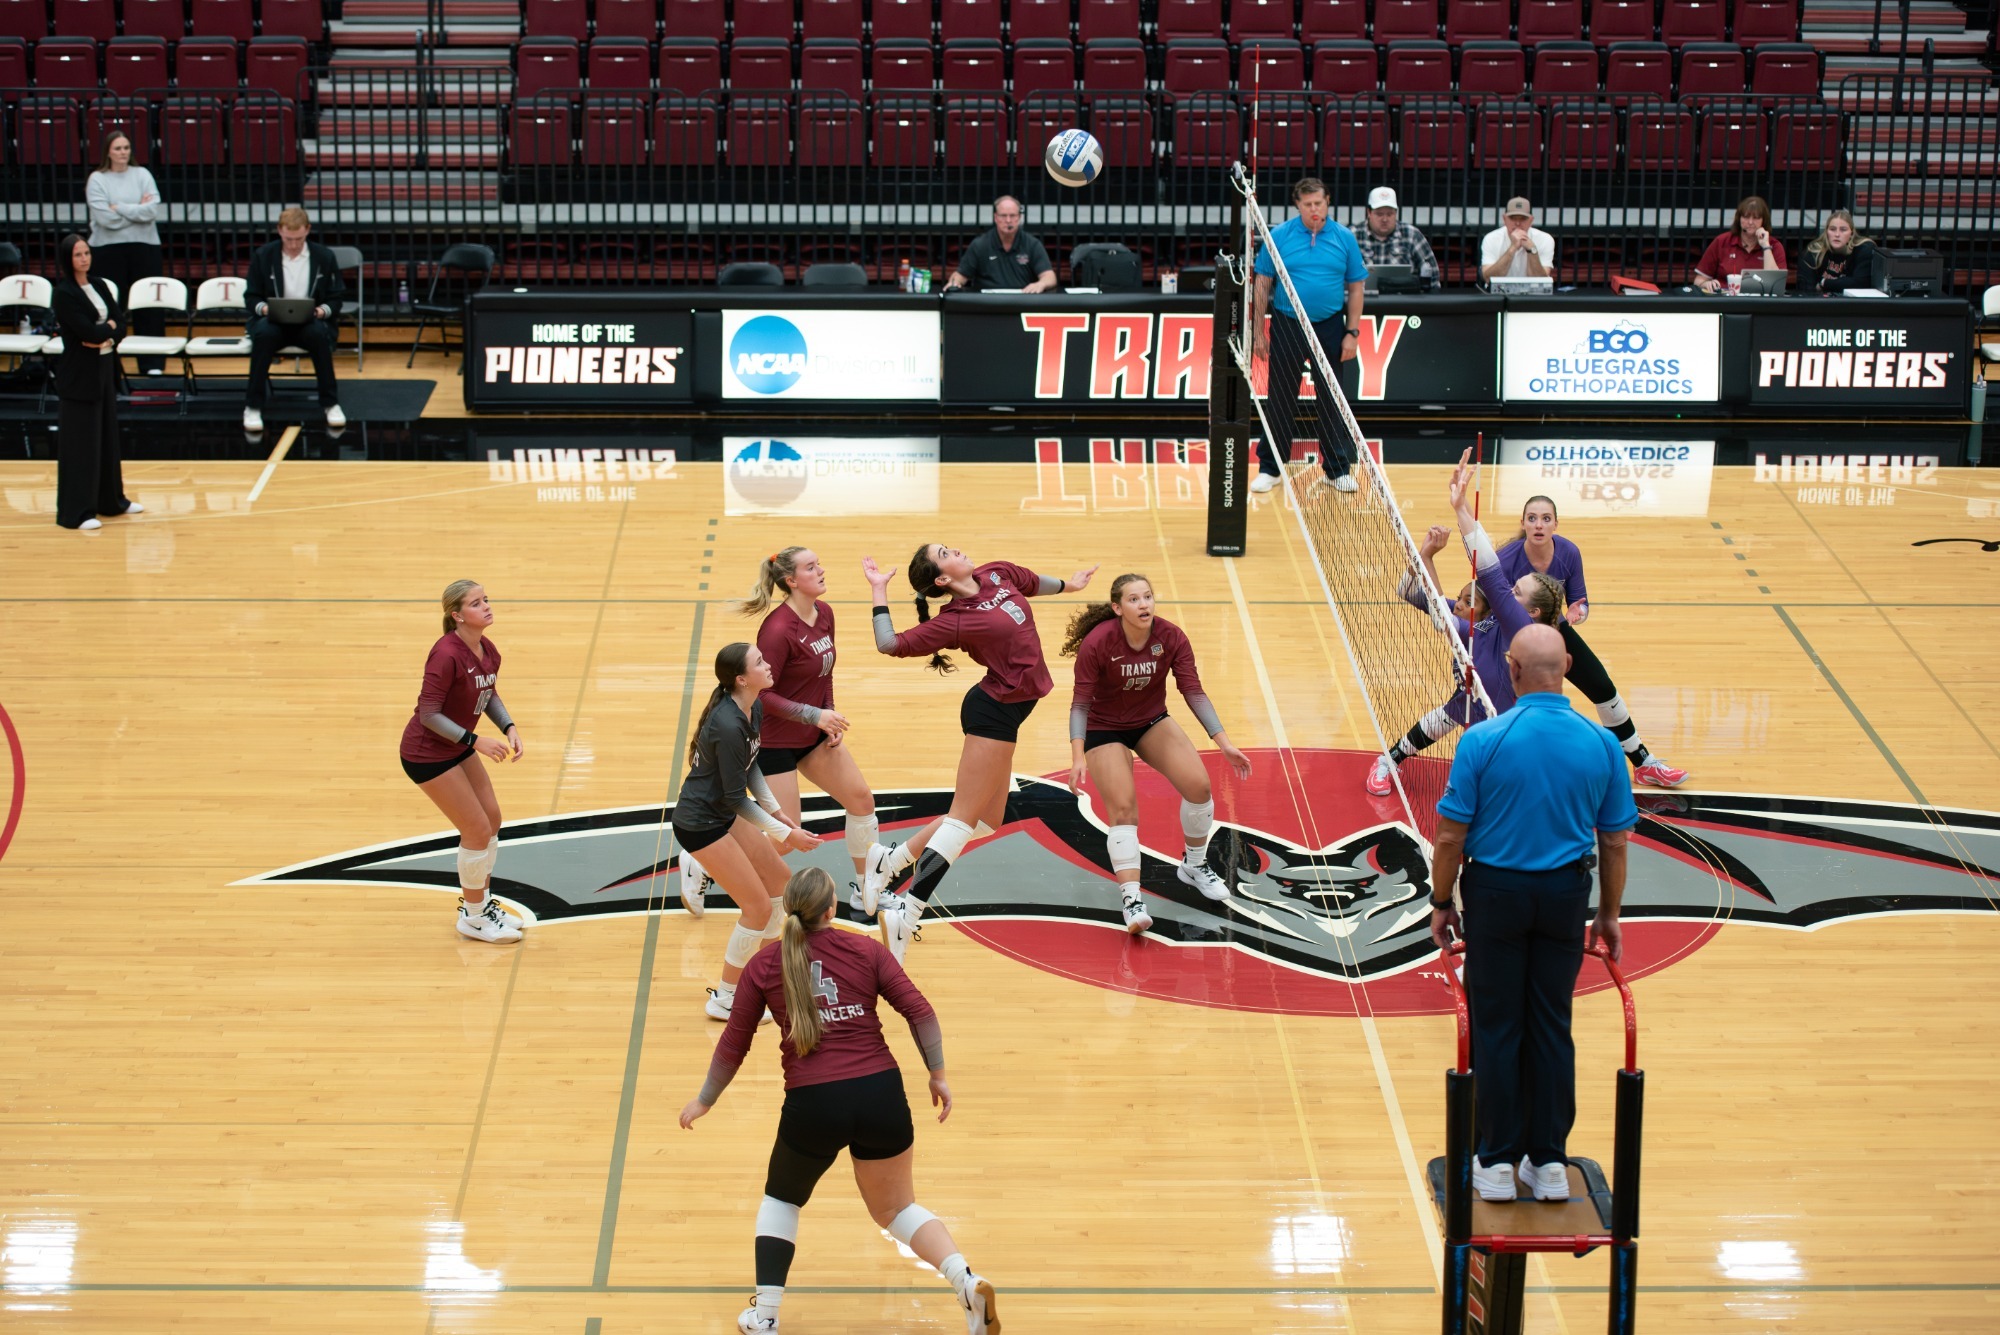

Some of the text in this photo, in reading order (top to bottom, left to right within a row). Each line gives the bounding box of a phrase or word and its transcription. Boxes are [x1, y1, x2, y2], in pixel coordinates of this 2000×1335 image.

[15, 279, 33, 300] T
[149, 282, 169, 302] T
[216, 281, 236, 301] T
[532, 324, 635, 343] HOME OF THE
[1589, 329, 1650, 354] BGO
[1807, 328, 1907, 347] HOME OF THE
[485, 347, 677, 384] PIONEERS
[735, 352, 807, 375] NCAA
[815, 355, 896, 375] Division
[1020, 312, 1408, 400] TRAY
[1546, 358, 1680, 375] BLUEGRASS
[1759, 351, 1948, 388] PIONEERS
[1529, 378, 1693, 394] ORTHOPAEDICS
[1223, 437, 1235, 508] sports imports
[1000, 600, 1026, 625] 6
[810, 635, 834, 655] TRANSY
[1120, 661, 1157, 677] TRANSY
[1123, 676, 1151, 691] 17
[810, 960, 839, 1005] 4
[818, 1003, 865, 1024] NEERS
